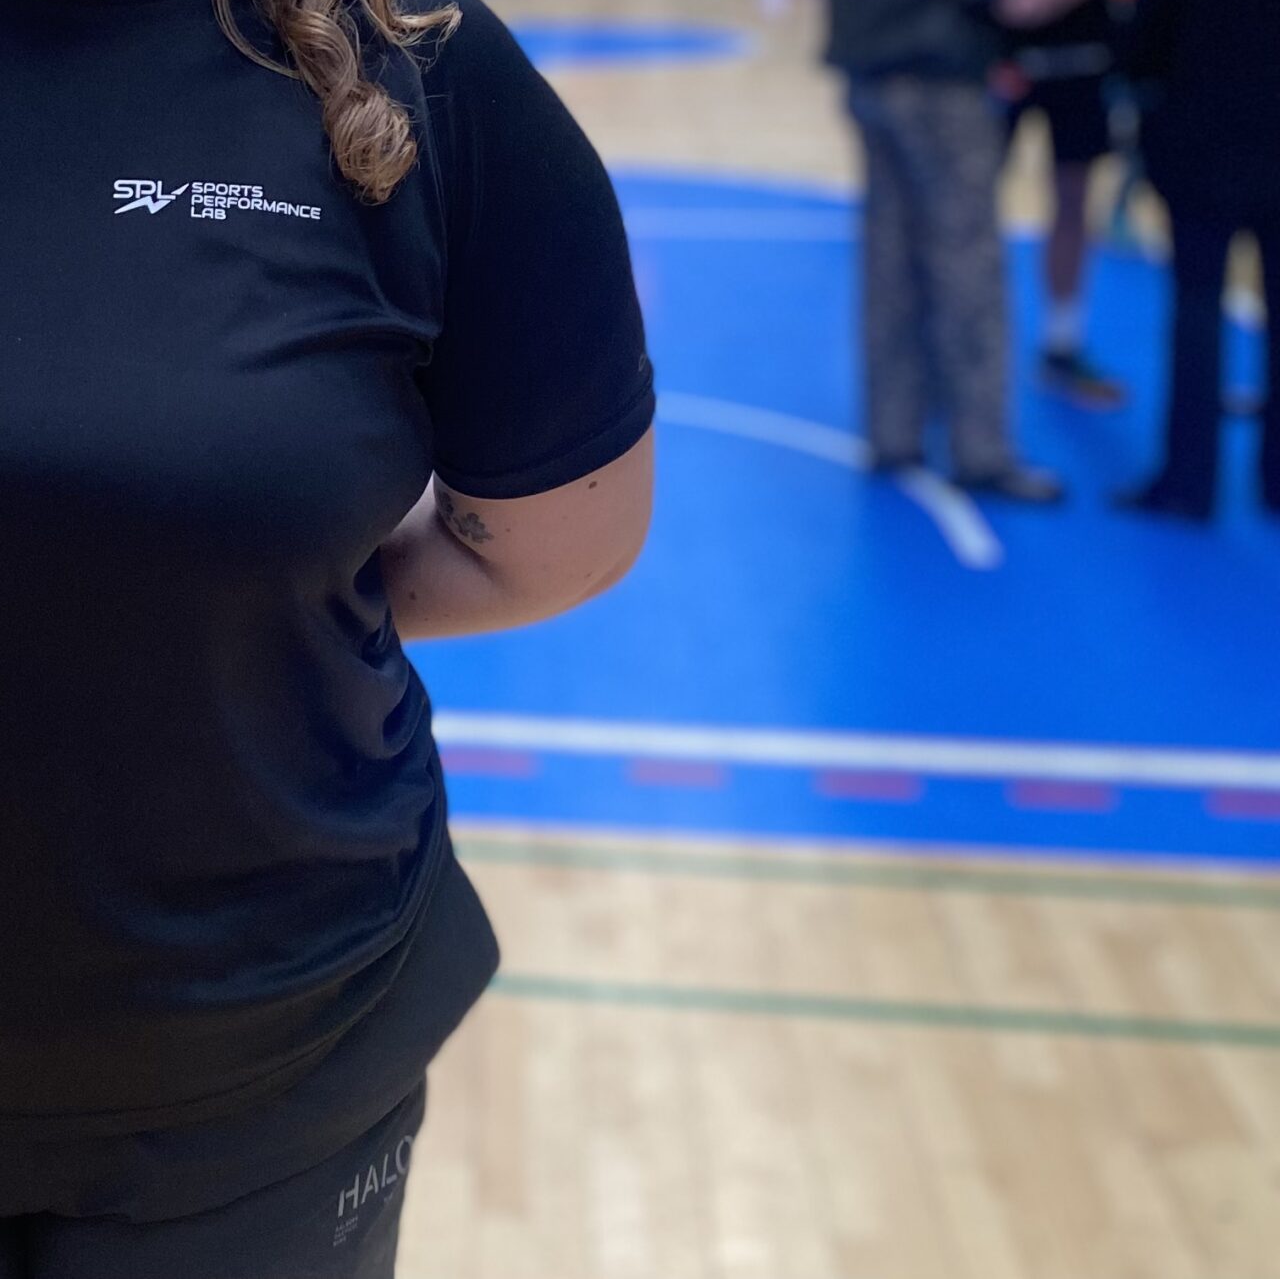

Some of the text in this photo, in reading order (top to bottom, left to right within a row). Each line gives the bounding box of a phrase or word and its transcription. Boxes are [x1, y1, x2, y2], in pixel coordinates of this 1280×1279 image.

[113, 179, 176, 200] SPL
[191, 182, 263, 198] SPORTS
[190, 207, 226, 220] LAB
[191, 195, 322, 219] PERFORMANCE
[337, 1135, 414, 1218] HALO
